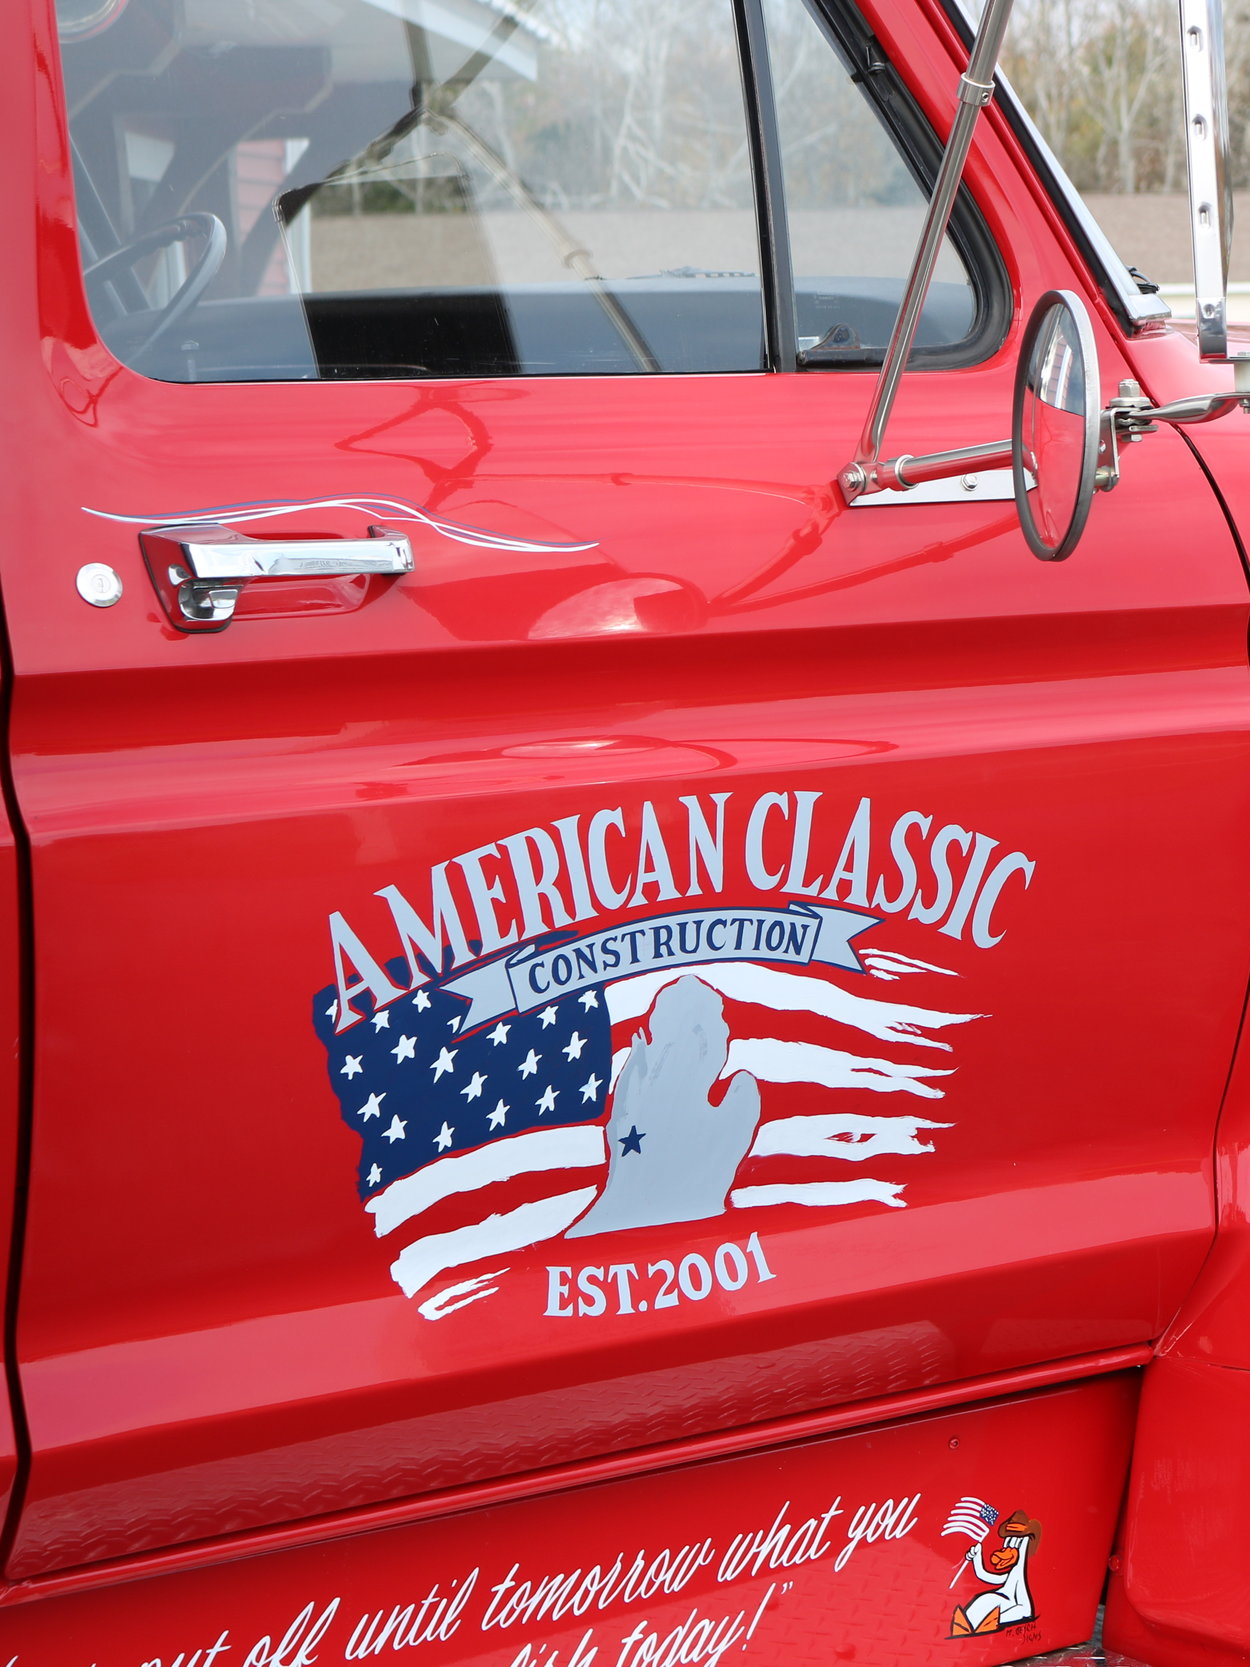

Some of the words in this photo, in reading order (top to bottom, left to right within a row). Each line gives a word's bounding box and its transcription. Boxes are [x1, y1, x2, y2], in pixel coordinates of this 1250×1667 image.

[328, 791, 734, 1035] AMERICAN
[744, 790, 1037, 949] CLASSIC
[526, 916, 812, 996] CONSTRUCTION
[344, 1567, 480, 1660] until
[481, 1537, 716, 1631] tomorrow
[716, 1495, 844, 1582] what
[833, 1493, 922, 1573] you
